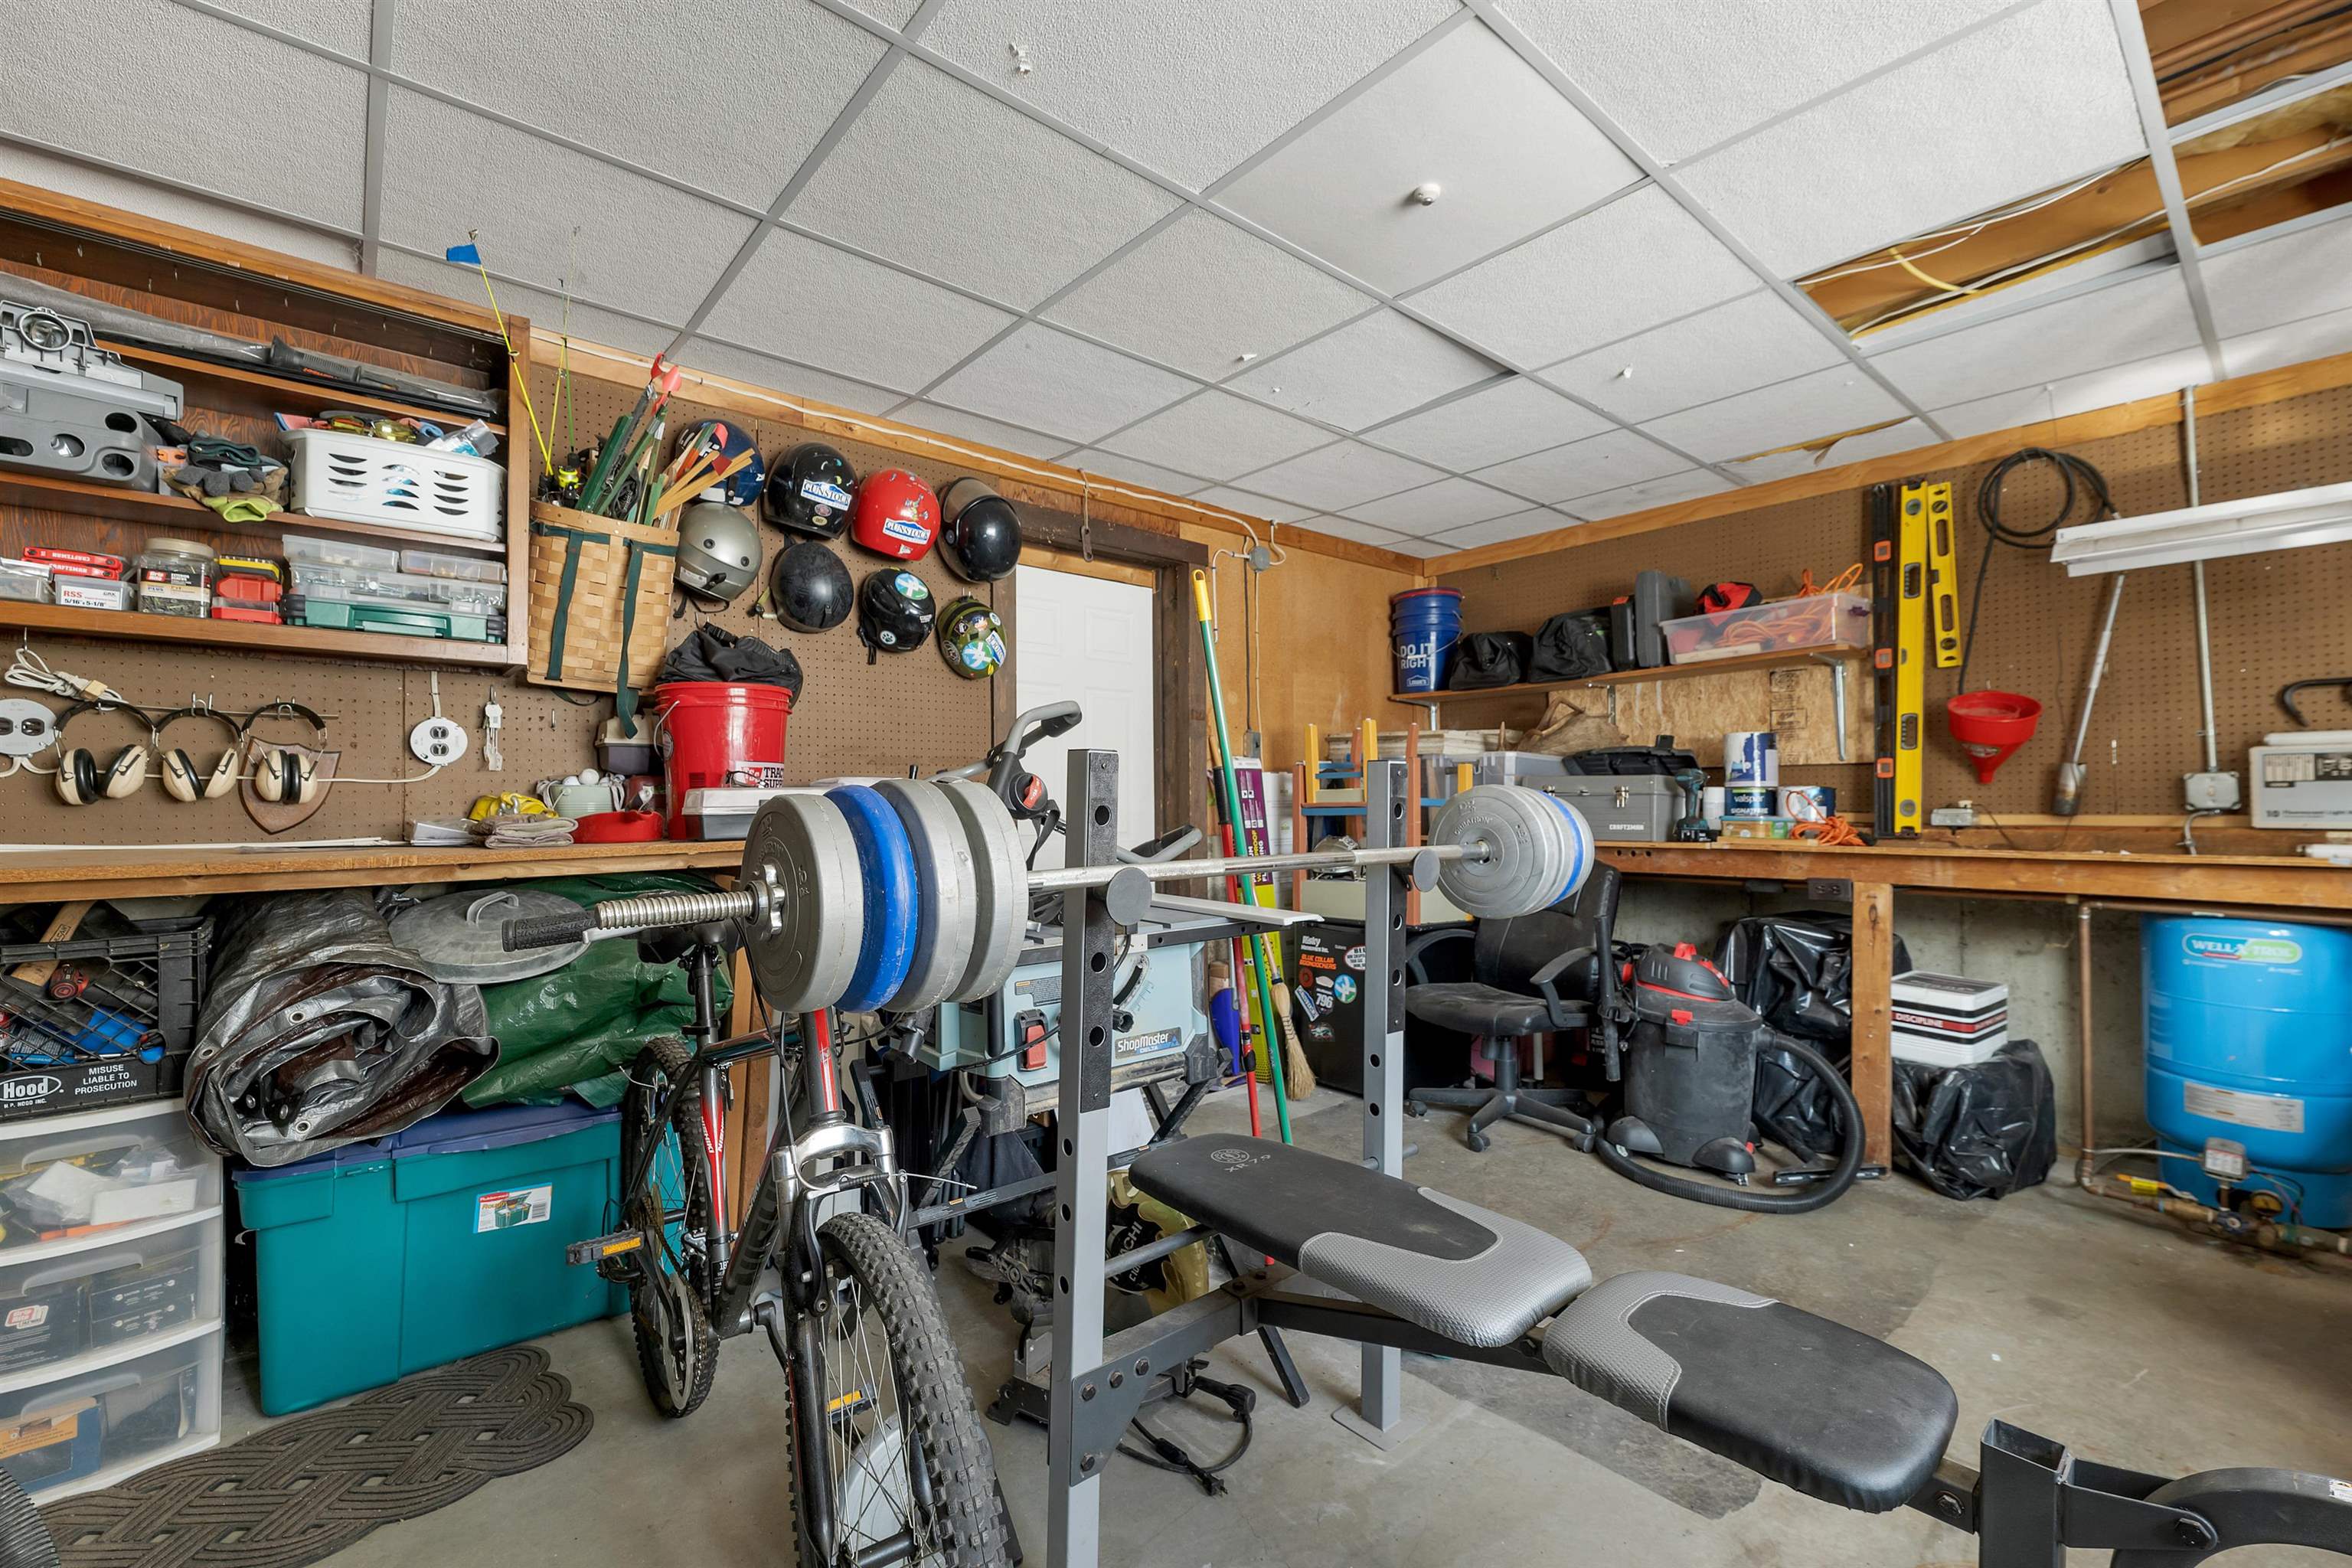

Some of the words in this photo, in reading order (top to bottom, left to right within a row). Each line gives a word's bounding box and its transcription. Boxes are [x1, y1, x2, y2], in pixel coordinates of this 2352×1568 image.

[804, 482, 850, 505] GUNSTOCK
[886, 520, 929, 538] GUNSTOCK
[1400, 644, 1416, 657] DO
[1420, 643, 1432, 655] IT
[1400, 657, 1432, 669] RIGHT
[1733, 795, 1765, 804] valspar
[1895, 1013, 1944, 1028] DISCIPLINE
[1118, 1033, 1168, 1052] ShopMaster
[89, 1064, 124, 1075] MISUSE
[83, 1073, 115, 1085] LIABLE
[117, 1072, 129, 1080] TO
[3, 1078, 49, 1099] Hood
[74, 1080, 137, 1095] PROSECUTION
